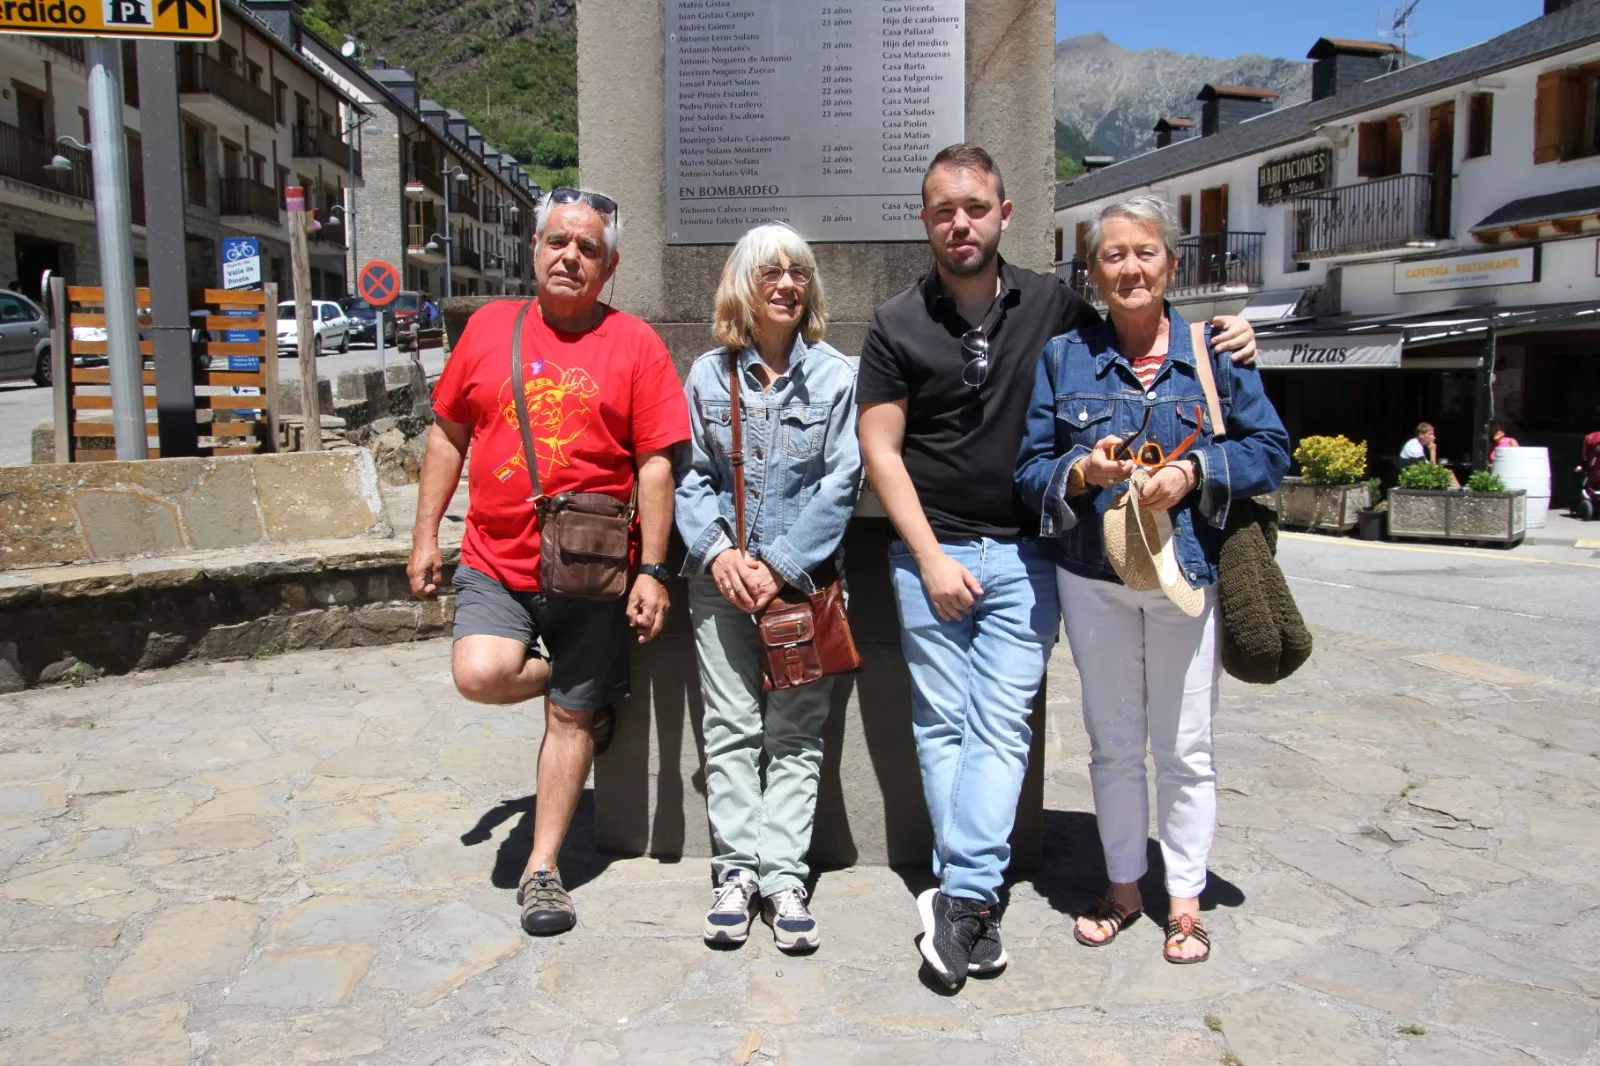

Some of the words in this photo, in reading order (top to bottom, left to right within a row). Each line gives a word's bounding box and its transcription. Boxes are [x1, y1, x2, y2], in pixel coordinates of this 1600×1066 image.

[678, 13, 696, 21] Juan
[698, 12, 724, 20] Gistau
[726, 11, 754, 19] Campo
[882, 17, 900, 26] Hijo
[678, 24, 705, 32] Andrés
[708, 23, 735, 31] Gómez
[678, 35, 708, 43] Antonio
[678, 46, 709, 54] Antonio
[711, 44, 750, 53] Montañés
[882, 40, 900, 49] Hijo
[678, 58, 709, 66] Antonio
[712, 57, 745, 65] Noguero
[904, 62, 925, 70] Barta
[712, 68, 746, 77] Noguero
[904, 73, 943, 82] Fulgencio
[679, 80, 705, 88] Ismael
[707, 78, 732, 86] Pañart
[735, 78, 760, 86] Solans
[904, 85, 930, 93] Mairal
[679, 92, 695, 100] José
[697, 90, 721, 98] Piniés
[730, 101, 762, 109] Ecudero
[904, 108, 935, 116] Saludas
[680, 114, 695, 122] José
[698, 113, 728, 121] Saludas
[730, 112, 764, 120] Escalona
[680, 125, 695, 134] José
[680, 136, 716, 145] Domingo
[718, 135, 743, 143] Solans
[745, 135, 790, 143] Casasnovas
[734, 146, 772, 154] Montaner
[680, 159, 704, 167] Mateo
[706, 158, 732, 166] Solans
[680, 170, 711, 178] Antonio
[712, 169, 738, 177] Solans
[740, 168, 758, 176] Villa
[1260, 153, 1325, 187] HABITACIONES
[680, 187, 695, 196] EN
[699, 185, 779, 196] BOMBARDEO
[680, 206, 715, 214] Victorino
[718, 205, 746, 213] Calvera
[749, 204, 787, 213] (maestro)
[903, 202, 922, 211] Agus
[680, 218, 713, 226] Leontina
[228, 268, 244, 276] Valle
[1405, 264, 1450, 279] CAFETERÍA
[1456, 257, 1519, 273] RESTAURANTE
[1290, 343, 1348, 363] Pizzas
